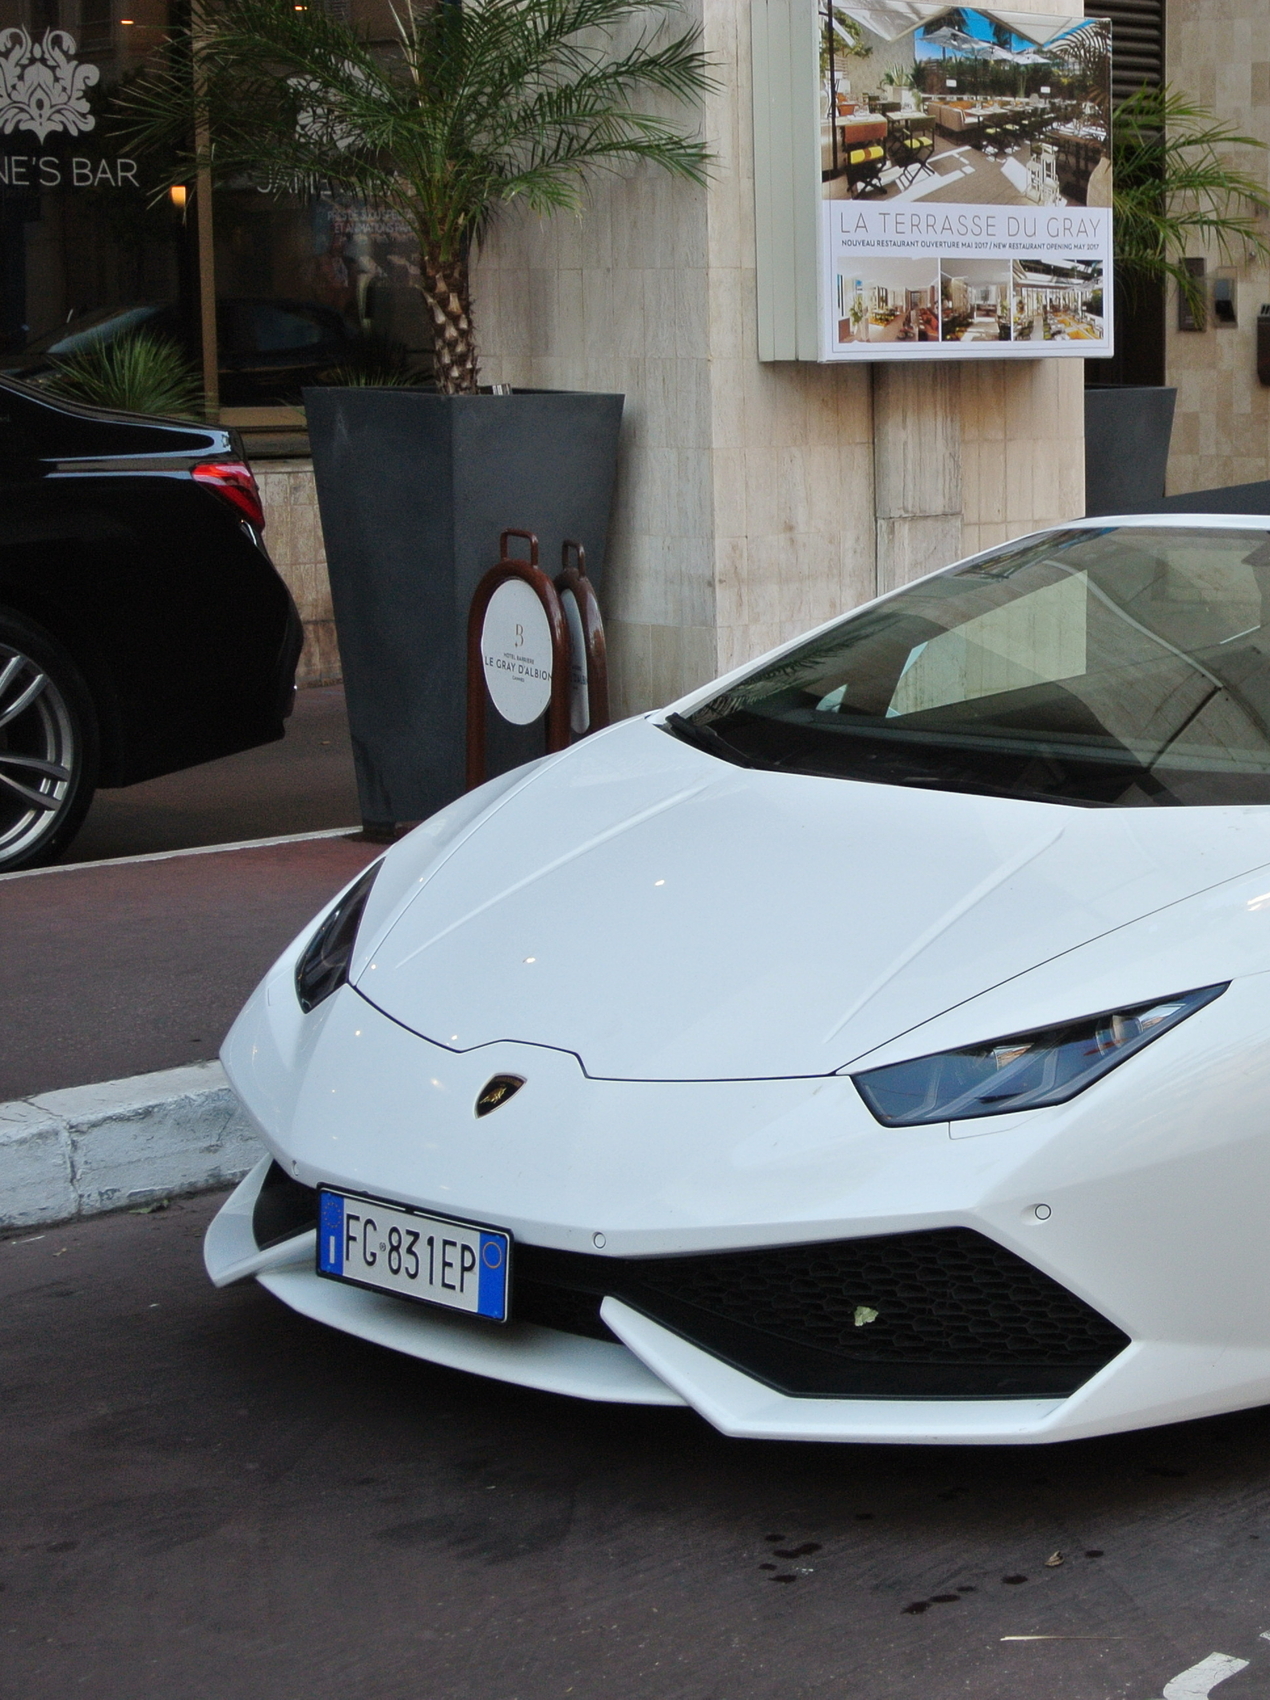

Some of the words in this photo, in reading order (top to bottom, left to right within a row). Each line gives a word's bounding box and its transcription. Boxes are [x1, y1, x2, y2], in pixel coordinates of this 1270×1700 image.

[73, 157, 140, 188] BAR
[840, 212, 869, 234] LA
[879, 213, 996, 236] TERRASSE
[1007, 216, 1037, 238] DU
[1047, 217, 1101, 239] GRAY
[841, 239, 875, 247] NOUVEAU
[876, 240, 919, 248] RESTAURANT
[921, 240, 960, 248] OUVERTURE
[961, 241, 973, 249] MAI
[1008, 242, 1045, 250] RESTAURANT
[1073, 243, 1086, 251] MAY
[485, 656, 494, 667] LE
[496, 659, 516, 672] GRAY
